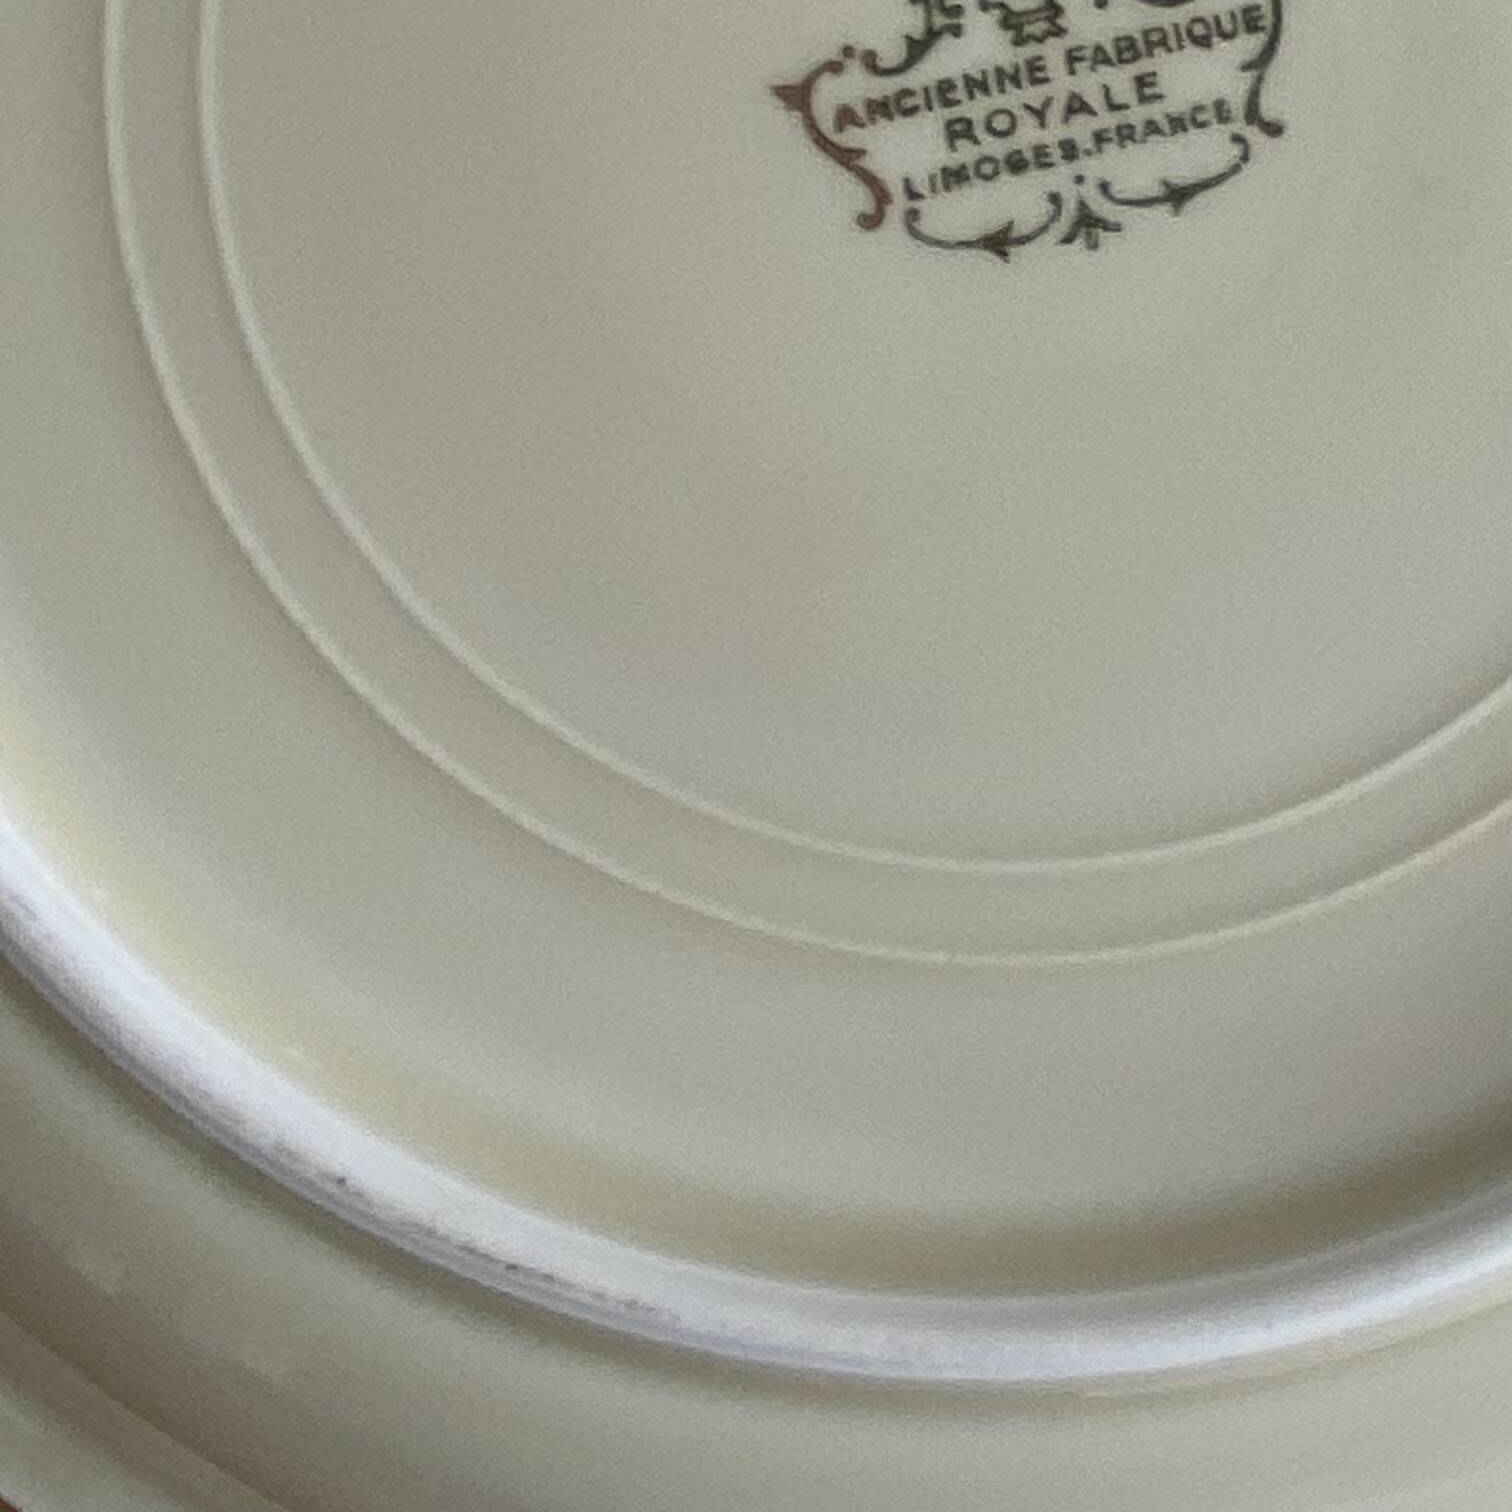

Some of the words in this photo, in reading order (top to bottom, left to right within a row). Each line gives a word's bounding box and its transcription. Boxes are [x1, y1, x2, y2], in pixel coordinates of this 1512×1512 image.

[834, 56, 1050, 133] ANCIENNE
[1064, 3, 1267, 77] FABRIQUE
[944, 70, 1166, 152] ROYALE
